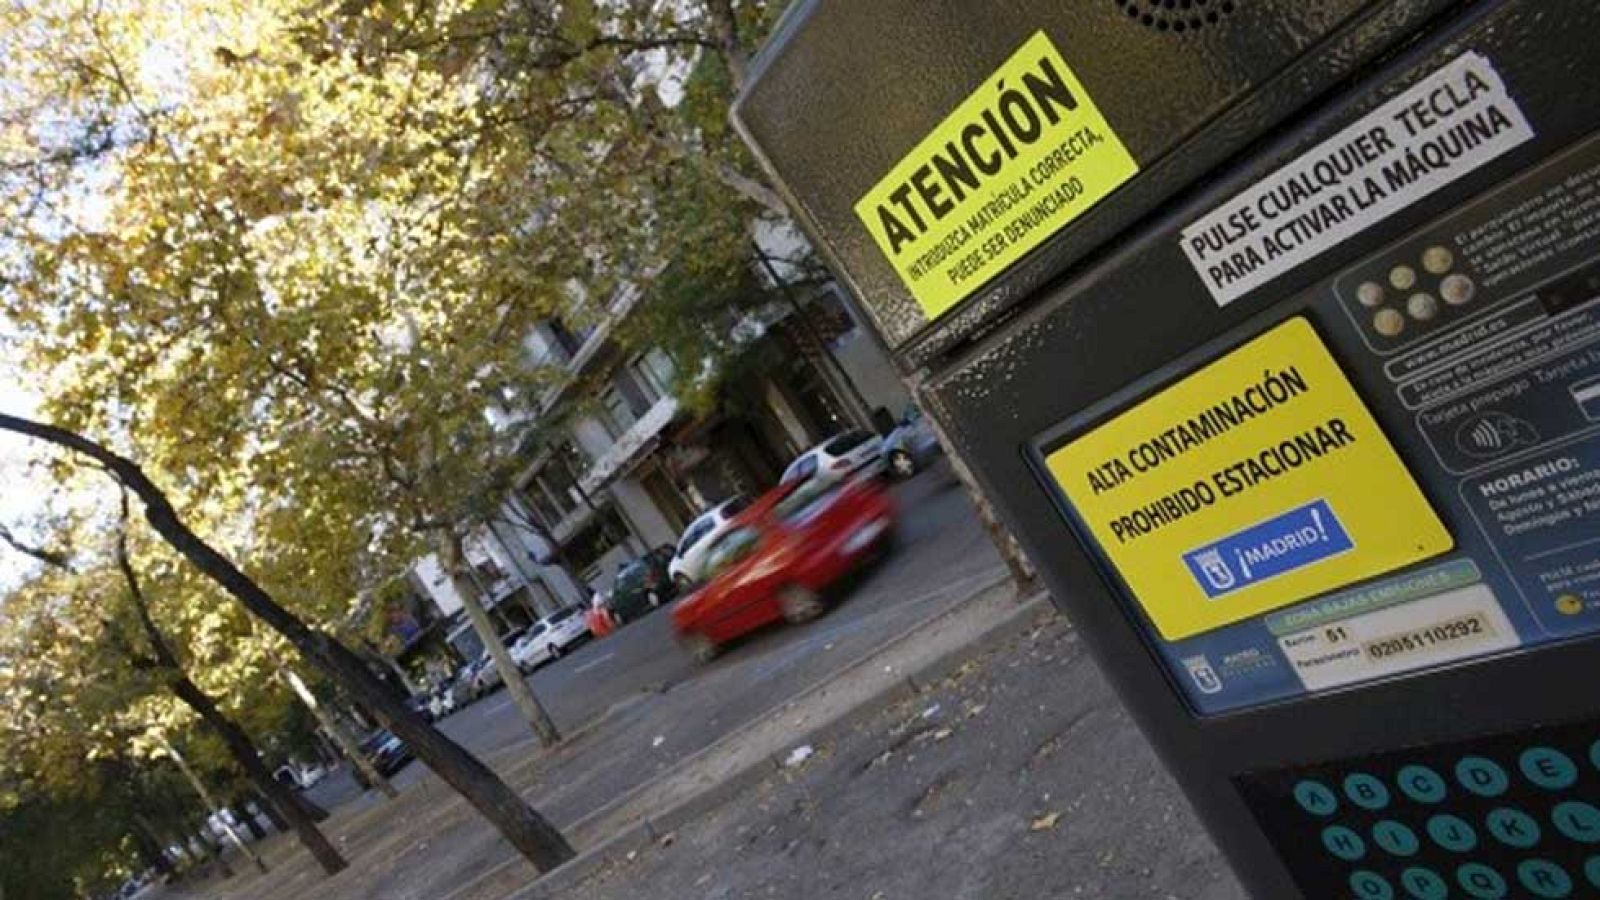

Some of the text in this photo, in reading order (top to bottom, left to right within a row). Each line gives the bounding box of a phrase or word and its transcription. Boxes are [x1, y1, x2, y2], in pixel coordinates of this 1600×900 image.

[876, 56, 1078, 255] ATENCIÓN
[1191, 70, 1490, 260] PULSE CUALQUIER TECLA
[907, 126, 1104, 280] INTRODUZCA MATRÍCULA CORRECTA,
[947, 176, 1084, 285] PUEDE SER DENUNCIADO
[1208, 104, 1513, 289] PARA ACTIVAR LA MÁQUINA
[1406, 320, 1507, 369] www.madrid.es
[1086, 366, 1308, 495] ALTA CONTAMINACIÓN
[1423, 404, 1468, 425] Tarjeta
[1470, 379, 1531, 412] prepago
[1109, 417, 1356, 543] PROHIBIDO ESTACIONAR
[1478, 458, 1580, 497] HORARIO:
[1234, 507, 1328, 578] ¡MADRID!
[1369, 618, 1482, 660] 0205110292
[1308, 758, 1560, 807] A B C D E
[1333, 834, 1352, 851] H
[1446, 825, 1462, 842] J
[1502, 817, 1526, 836] K
[1568, 813, 1592, 832] L
[1361, 868, 1556, 896] O P Q R
